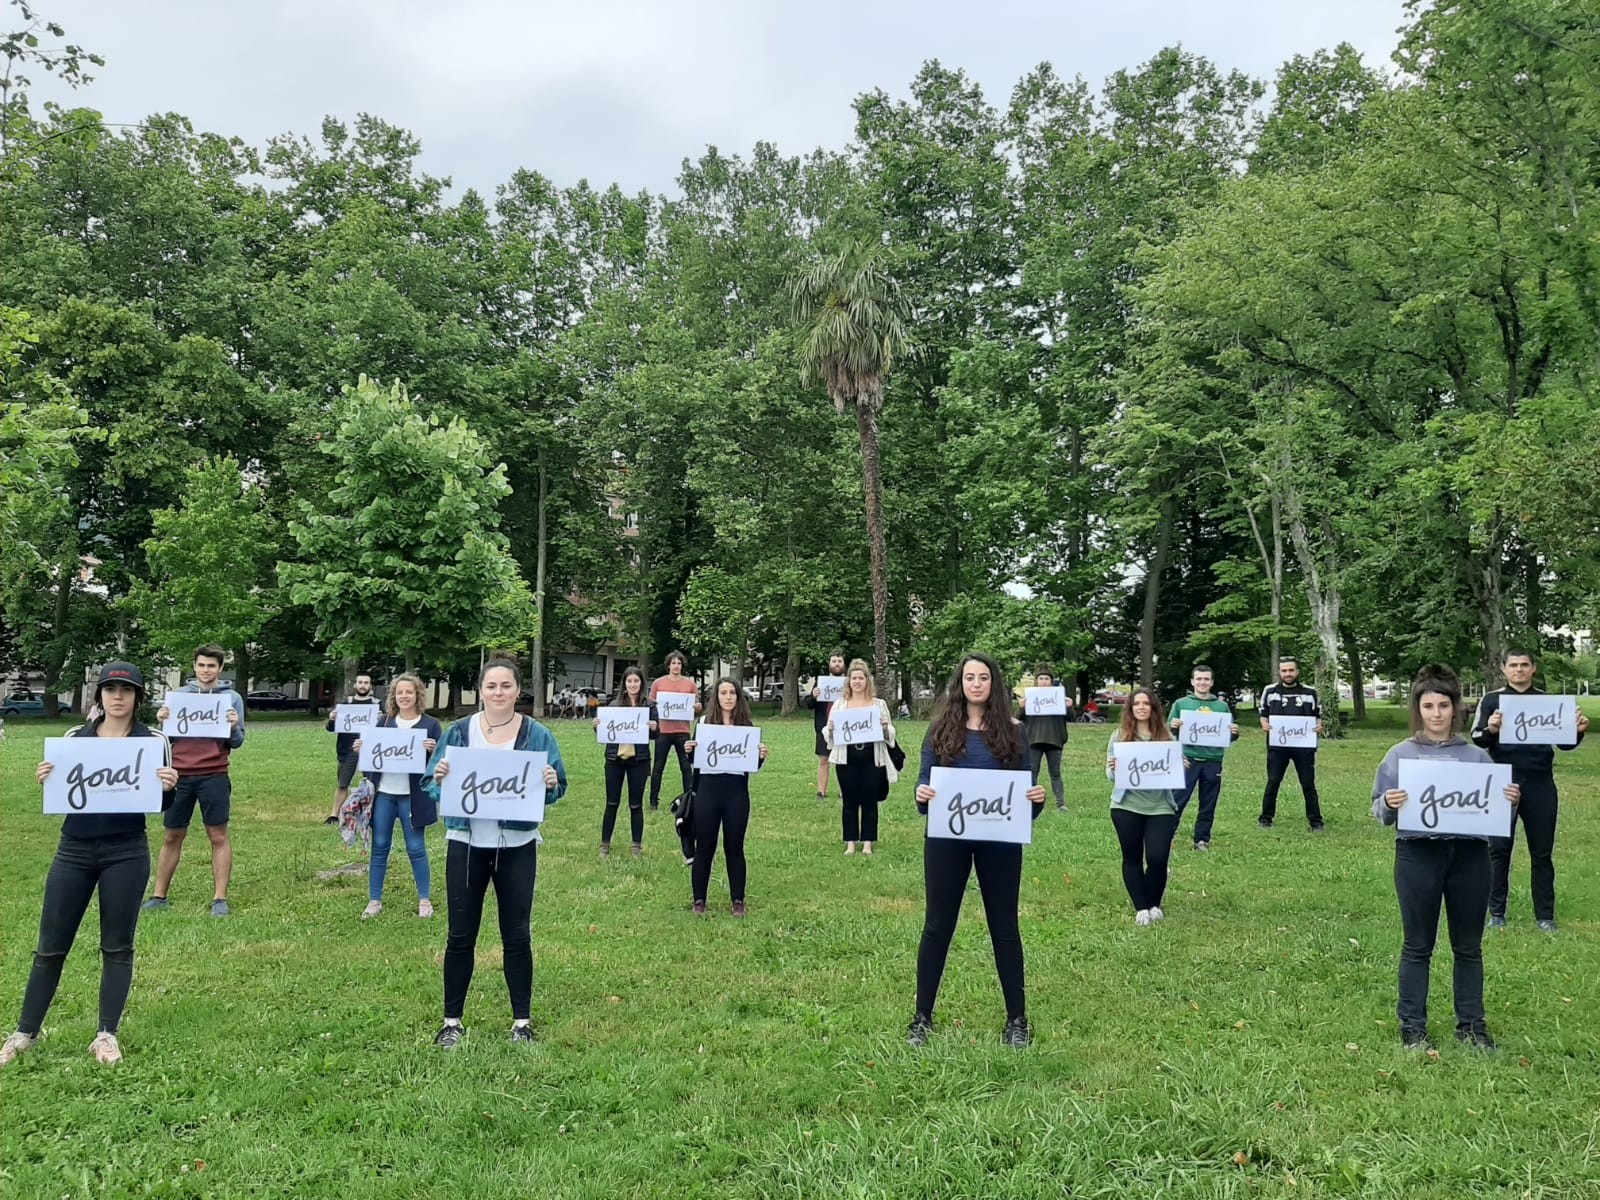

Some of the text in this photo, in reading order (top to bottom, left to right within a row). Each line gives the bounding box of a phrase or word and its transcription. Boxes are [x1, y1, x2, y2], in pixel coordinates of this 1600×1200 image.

[177, 701, 220, 734] gora!
[663, 697, 688, 718] gora!
[1033, 691, 1057, 713] gora!
[344, 709, 372, 731] gora!
[607, 712, 640, 742] gora!
[842, 712, 872, 742] gora!
[1189, 718, 1222, 743] gora!
[1278, 721, 1308, 745] gora!
[1514, 703, 1563, 741] gora!
[372, 736, 415, 770] gora!
[707, 734, 749, 767] gora!
[67, 748, 144, 810] gora!
[1128, 749, 1171, 787] gora!
[461, 761, 531, 815] gora!
[1420, 774, 1493, 829] gora!
[948, 781, 1015, 836] gora!
